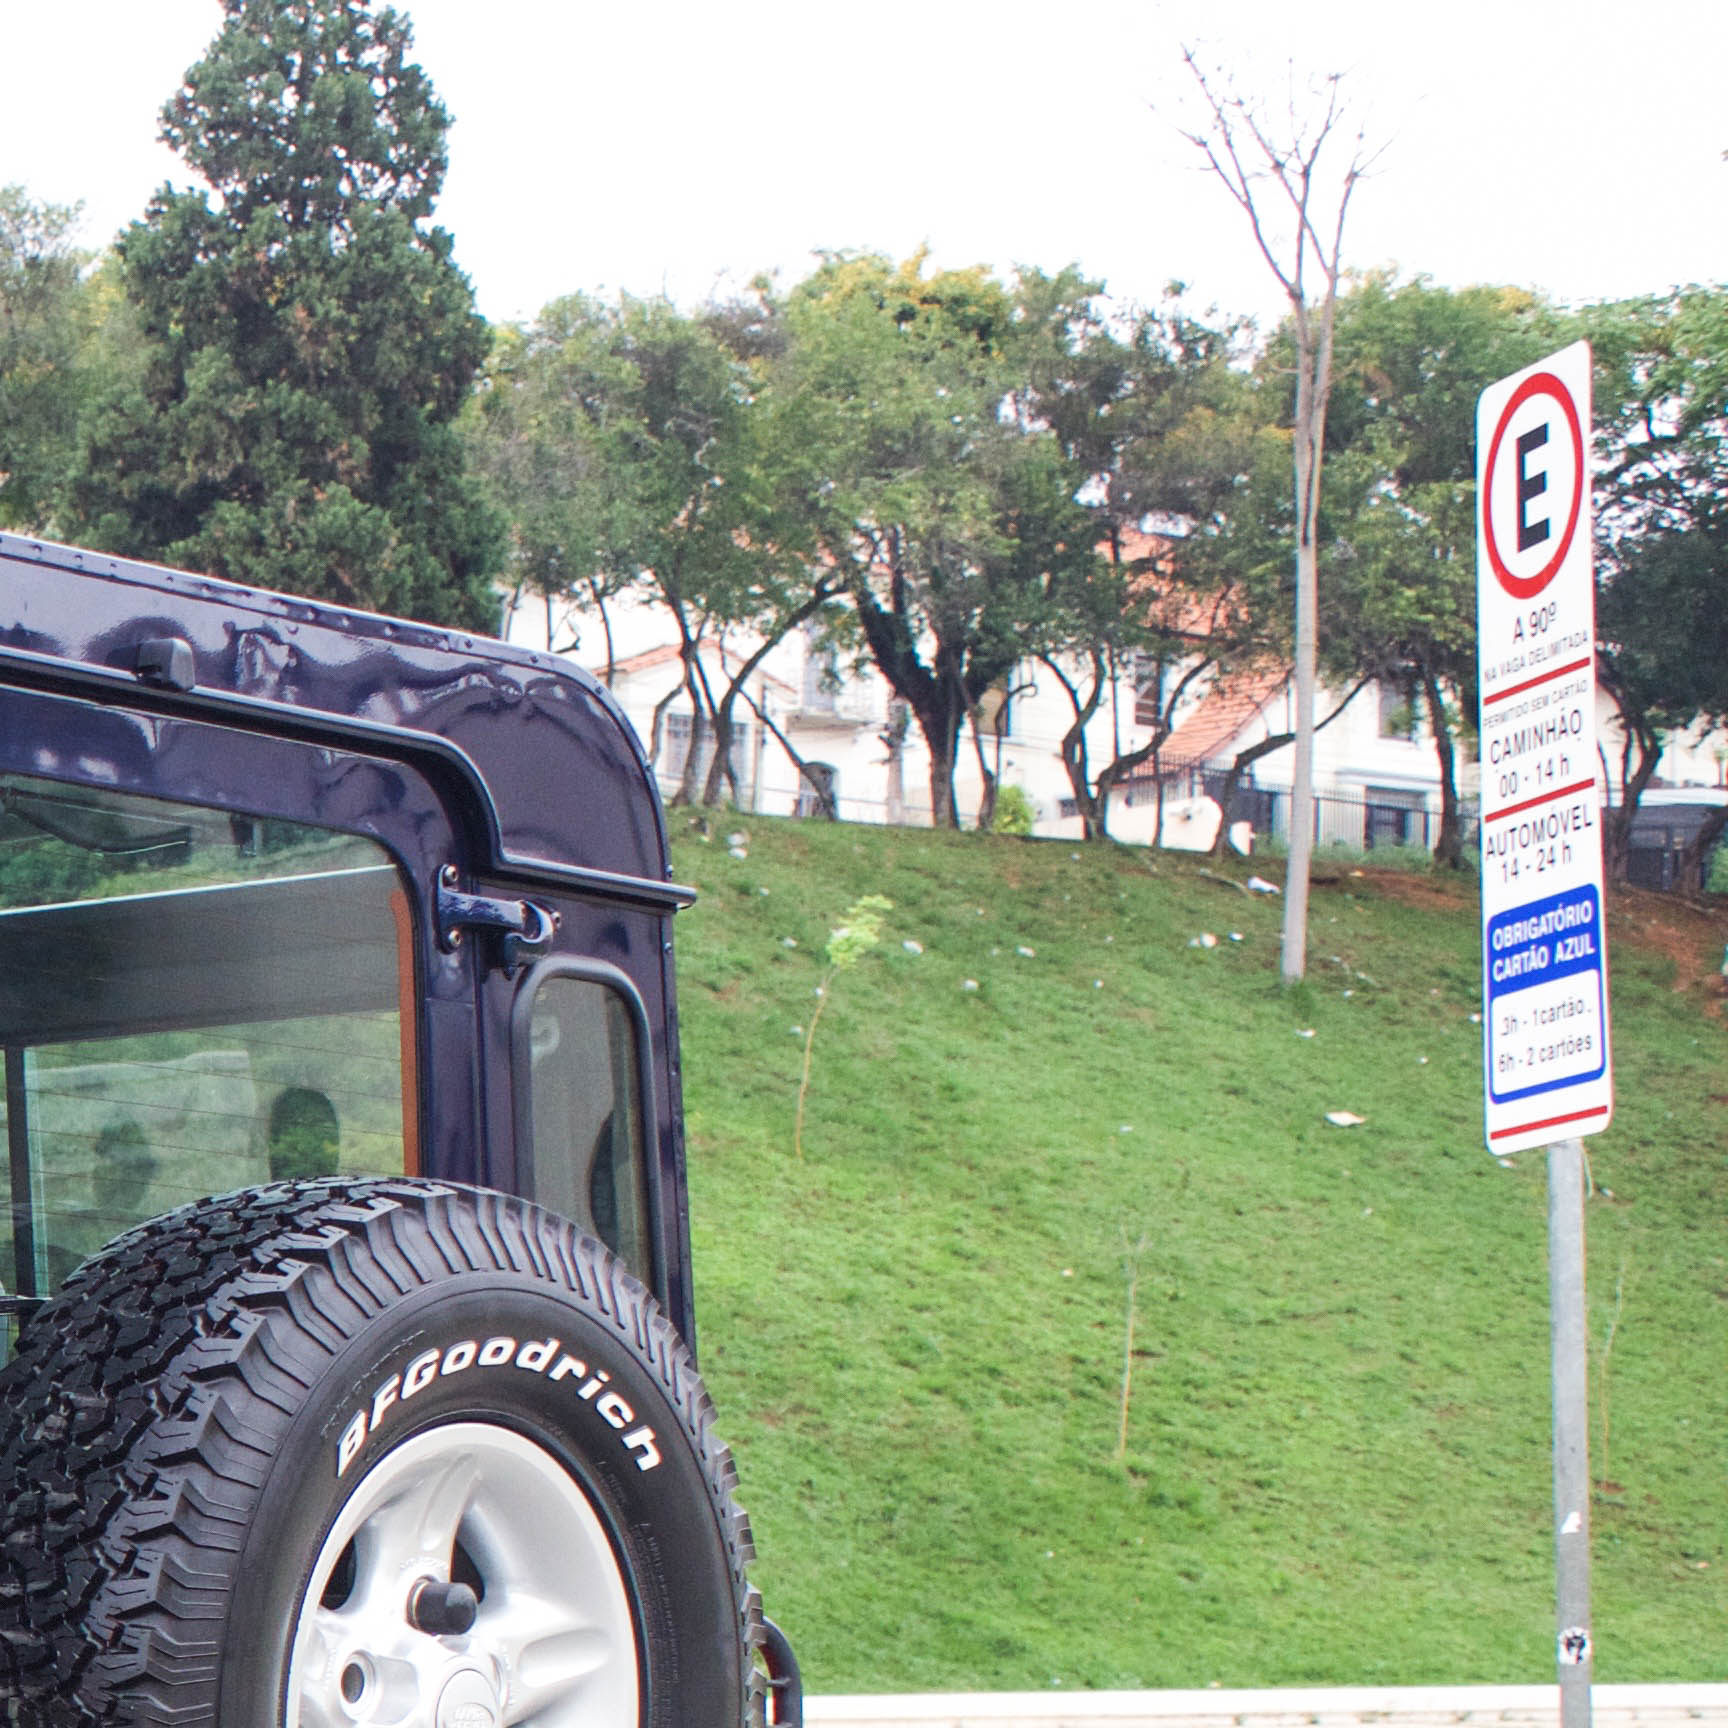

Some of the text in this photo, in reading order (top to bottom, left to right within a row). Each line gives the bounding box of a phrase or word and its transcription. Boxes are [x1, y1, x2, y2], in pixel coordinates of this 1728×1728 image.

[1516, 422, 1549, 553] E
[1484, 630, 1588, 682] NA VAGA DELIMITADA
[1512, 616, 1525, 645] A
[1490, 707, 1582, 765] CAMINHÃO
[1535, 758, 1553, 785] 14
[1560, 752, 1569, 777] h
[1485, 804, 1593, 861] AUTOMÓVEL
[1502, 857, 1519, 884] 14
[1537, 845, 1556, 873] 24
[1562, 841, 1572, 865] h
[1492, 900, 1593, 952] OBRIGATÓRIO
[1493, 932, 1597, 983] CARTÃO AZUL
[1500, 1015, 1518, 1036] 3h
[1527, 1046, 1534, 1066] 2
[1539, 1034, 1592, 1061] cartões
[337, 1336, 663, 1477] BFGoodrich
